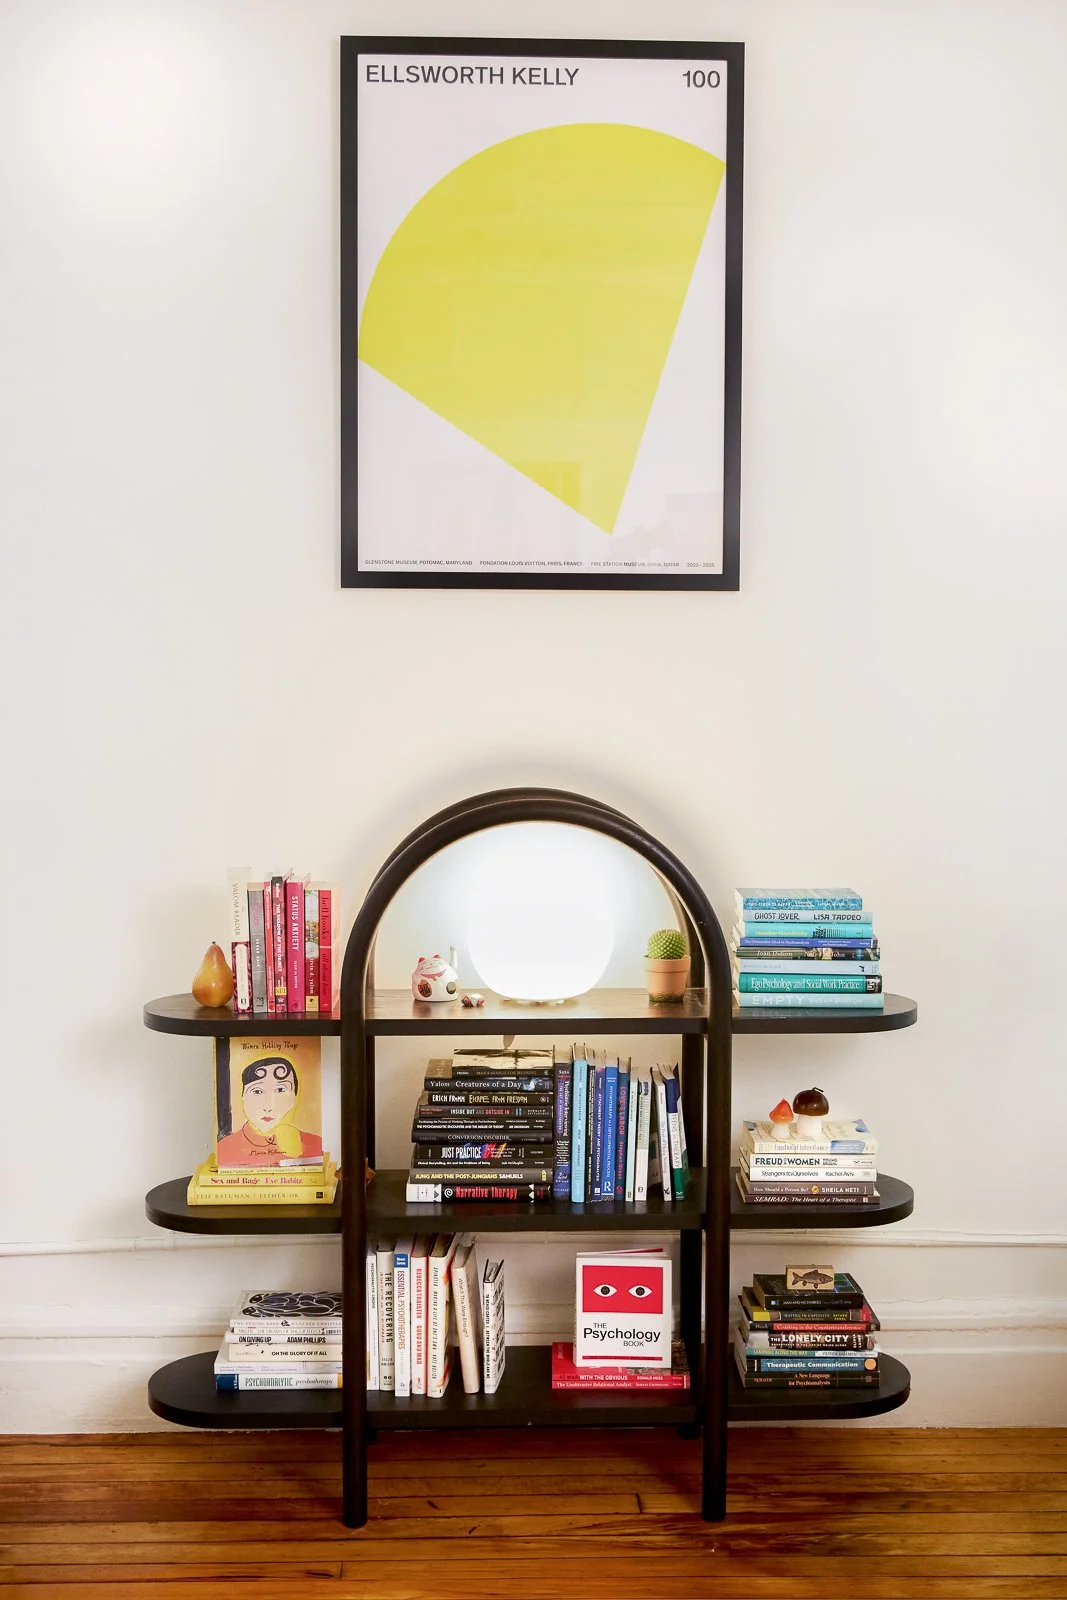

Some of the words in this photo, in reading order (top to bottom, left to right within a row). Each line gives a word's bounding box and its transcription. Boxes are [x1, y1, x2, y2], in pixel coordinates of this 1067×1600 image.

[365, 64, 504, 85] ELLSWORTH
[512, 67, 580, 86] KELLY
[682, 70, 721, 89] 100
[291, 896, 299, 920] STATUS
[291, 922, 299, 951] ANXIETY
[751, 978, 761, 991] Ego
[762, 978, 793, 990] Psychology
[806, 979, 822, 989] Social
[822, 979, 837, 988] Work
[838, 979, 859, 989] Practice
[752, 995, 806, 1005] EMPTY
[507, 1081, 522, 1090] Day
[449, 1095, 465, 1103] FROMM
[441, 1147, 455, 1158] JUST
[455, 1147, 482, 1159] PRACTICE
[672, 1140, 680, 1167] THERAPY
[755, 1157, 783, 1165] FREUD
[242, 1177, 260, 1185] Rage
[455, 1186, 489, 1198] Narrative
[492, 1187, 518, 1199] Therapy
[385, 1290, 393, 1343] RECOVERING
[398, 1300, 406, 1350] PSYCHOTHERAPIES
[461, 1317, 469, 1338] Enough?
[583, 1327, 661, 1342] Psychology
[782, 1335, 822, 1343] LONELY
[824, 1335, 849, 1343] CITY
[245, 1378, 293, 1387] PSYCHOANALYTIC
